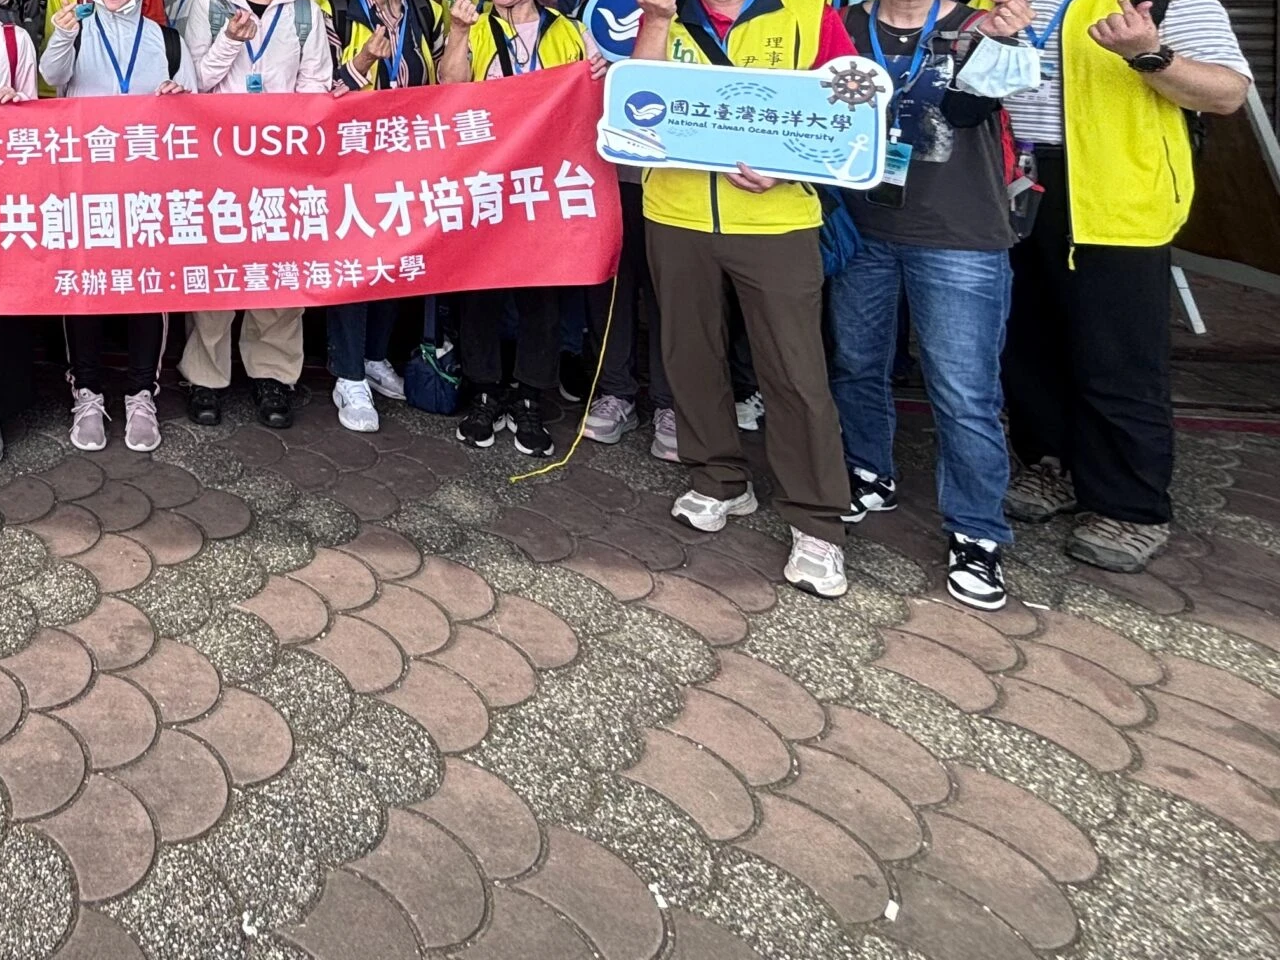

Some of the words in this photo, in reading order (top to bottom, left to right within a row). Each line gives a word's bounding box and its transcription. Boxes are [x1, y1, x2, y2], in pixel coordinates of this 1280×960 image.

[672, 38, 698, 64] tp
[765, 37, 784, 69] 理事
[667, 118, 708, 129] National
[712, 122, 745, 132] Taiwan
[747, 126, 779, 136] Ocean
[782, 129, 835, 143] University
[670, 99, 853, 133] 國立臺灣海洋大學
